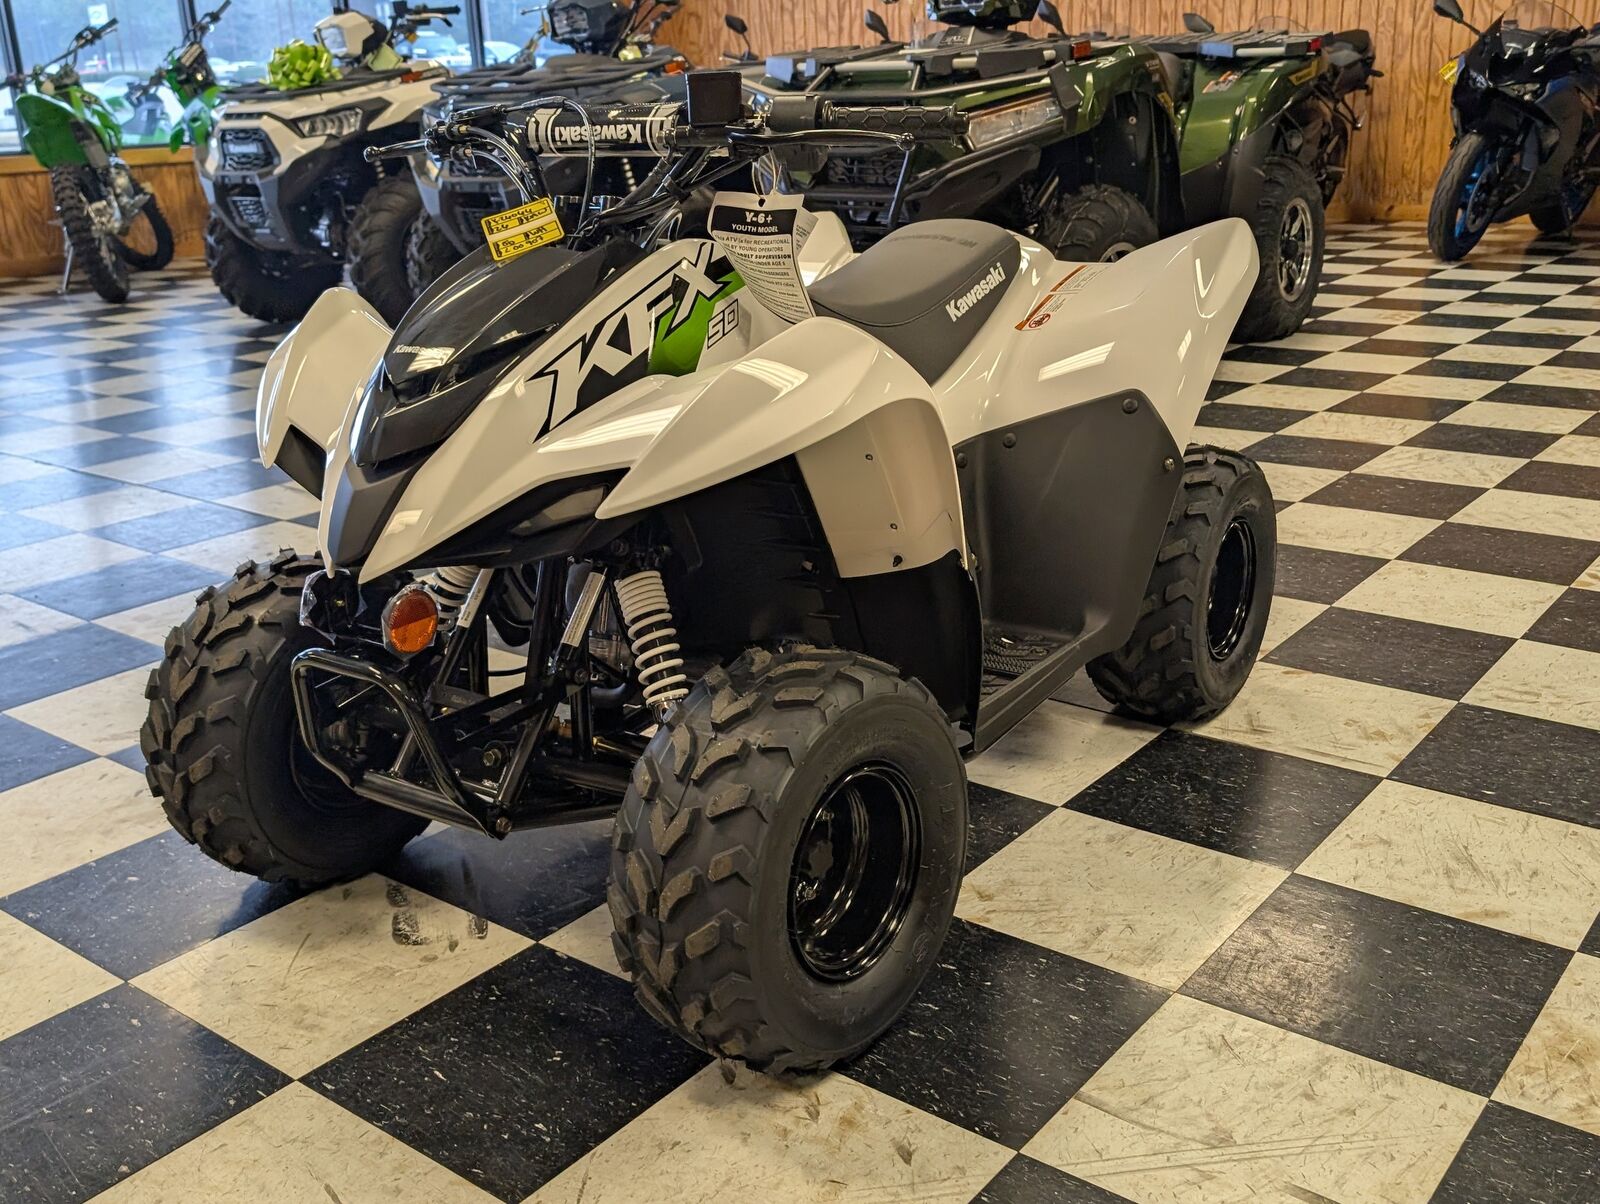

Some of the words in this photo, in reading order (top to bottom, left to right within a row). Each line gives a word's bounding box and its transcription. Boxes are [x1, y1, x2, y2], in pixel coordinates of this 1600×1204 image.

[555, 123, 643, 144] Kawasaki
[732, 223, 757, 233] YOUTH
[745, 211, 773, 224] Y-6+
[945, 262, 1006, 322] Kawasaki
[527, 240, 728, 443] KFX
[707, 299, 739, 350] 50
